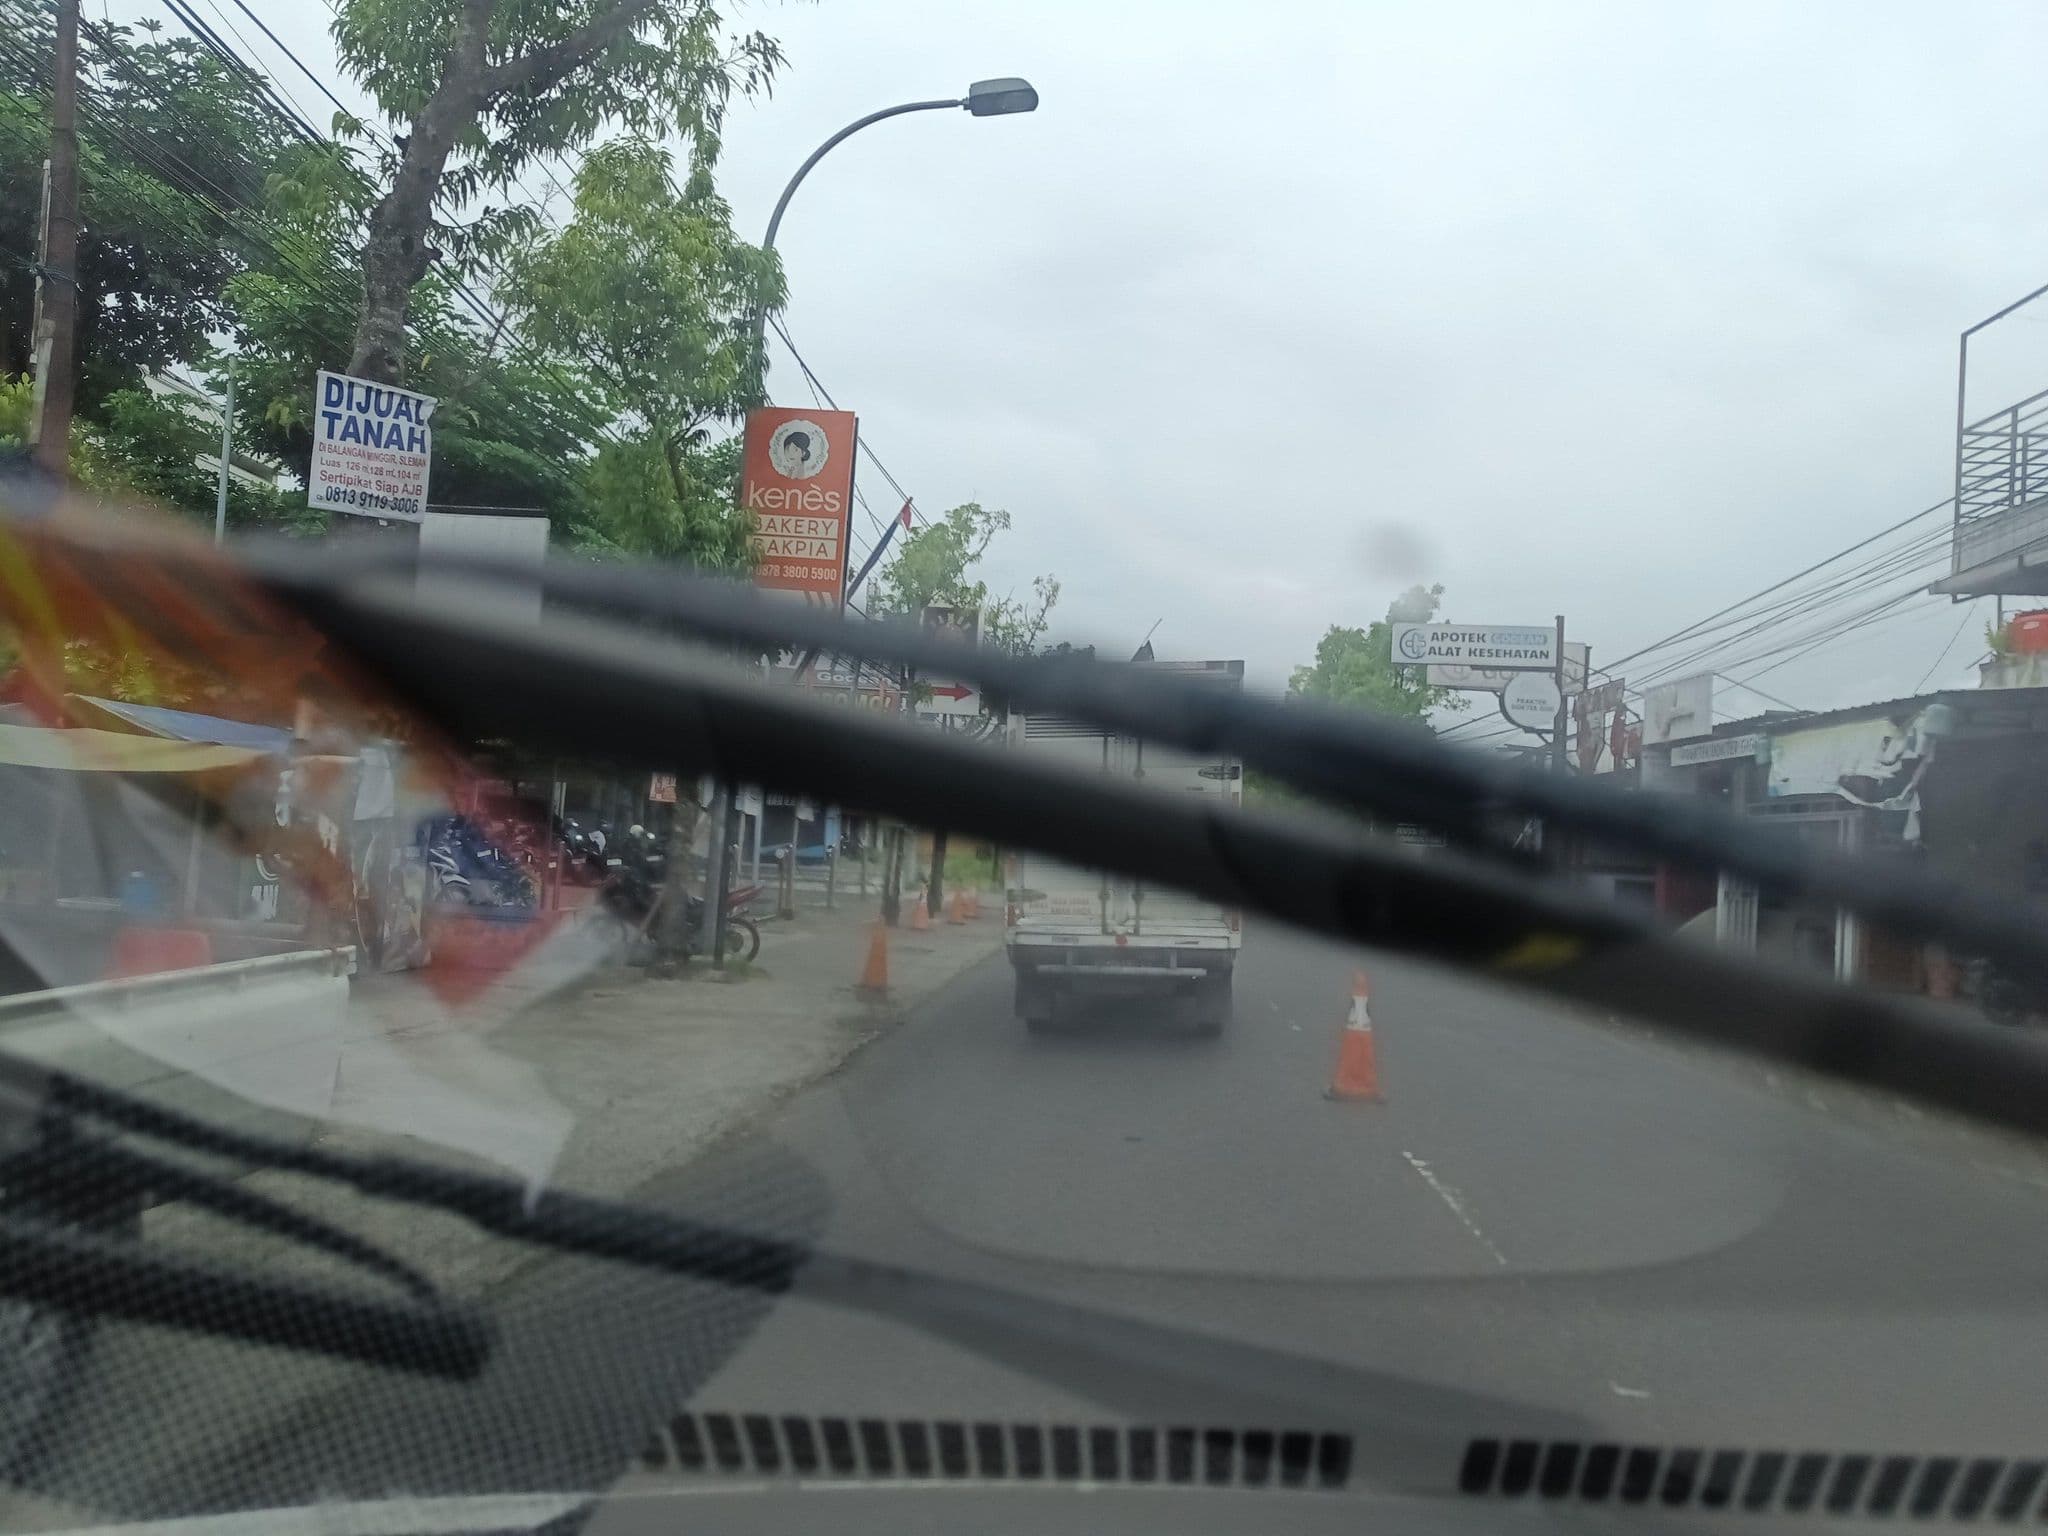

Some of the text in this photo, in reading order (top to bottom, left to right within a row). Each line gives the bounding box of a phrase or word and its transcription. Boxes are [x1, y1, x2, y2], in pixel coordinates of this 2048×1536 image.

[324, 376, 425, 426] DIJUAL
[321, 410, 426, 453] TANAH
[320, 457, 341, 468] Luas
[319, 470, 422, 496] Sertipikat Siap AJB
[749, 480, 841, 512] kenès
[325, 485, 356, 505] 0813
[359, 491, 388, 510] 9119
[390, 497, 419, 514] 3006
[782, 565, 809, 579] 3800
[811, 567, 838, 581] 5900
[1430, 631, 1487, 643] APOTEK
[1427, 646, 1550, 659] ALAT KESEHATAN
